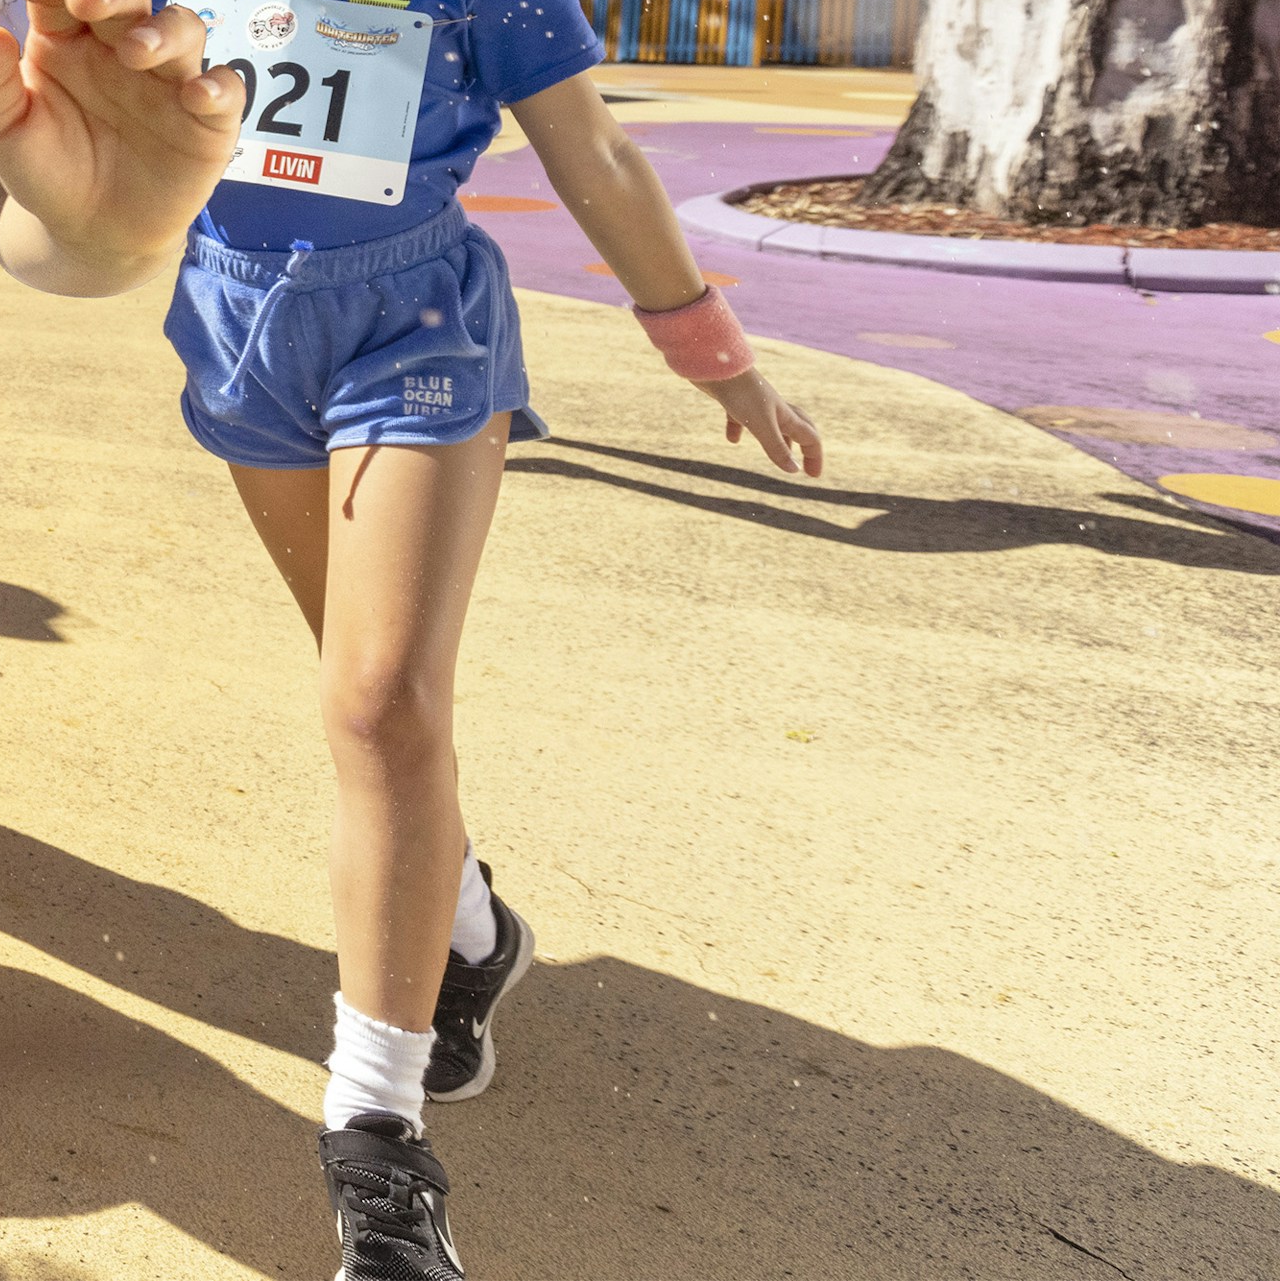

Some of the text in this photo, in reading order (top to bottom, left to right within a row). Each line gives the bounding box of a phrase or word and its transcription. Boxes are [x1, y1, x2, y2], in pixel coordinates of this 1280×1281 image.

[316, 21, 399, 45] WHITEWATER
[201, 58, 350, 142] 021
[270, 154, 315, 179] LIVIN
[403, 376, 453, 391] BLUE
[404, 390, 453, 407] OCEAN
